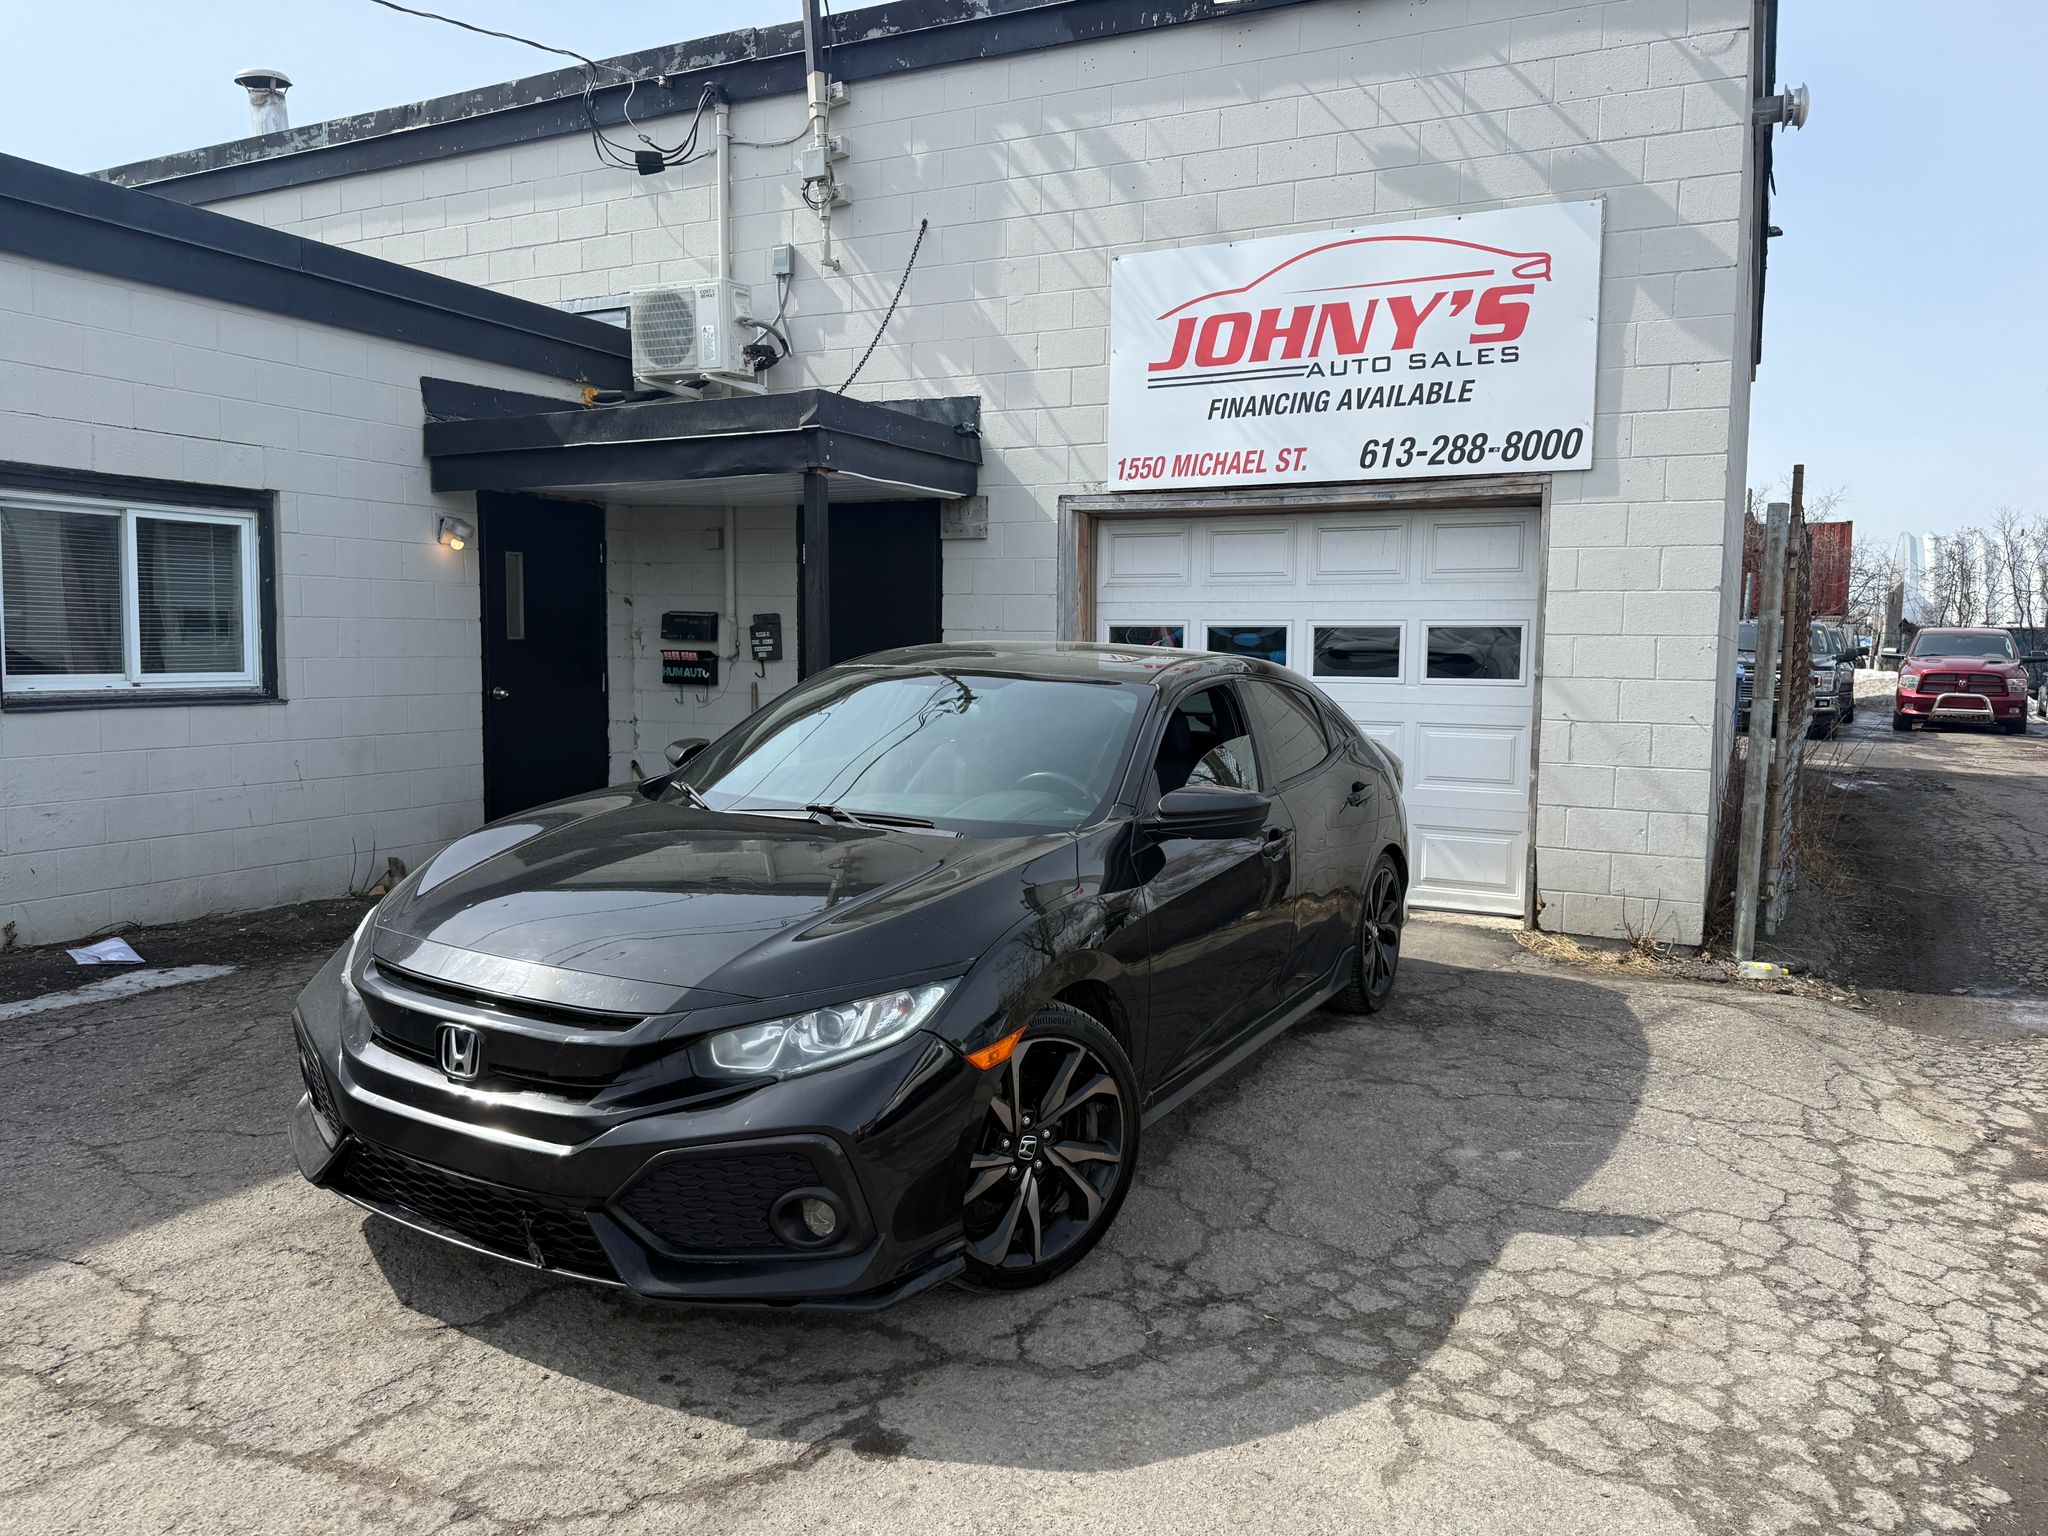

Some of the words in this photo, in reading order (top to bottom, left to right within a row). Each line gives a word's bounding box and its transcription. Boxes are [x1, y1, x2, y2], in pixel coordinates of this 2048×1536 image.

[1147, 283, 1535, 372] JOHNY'S
[1305, 355, 1391, 378] AUTO
[1409, 345, 1520, 369] SALES
[1208, 390, 1331, 420] FINANCING
[1336, 379, 1475, 411] AVAILABLE
[1117, 455, 1167, 481] 1550
[1171, 449, 1266, 477] MICHAEL
[1275, 447, 1308, 473] ST.
[1359, 428, 1583, 470] 613-288-8000
